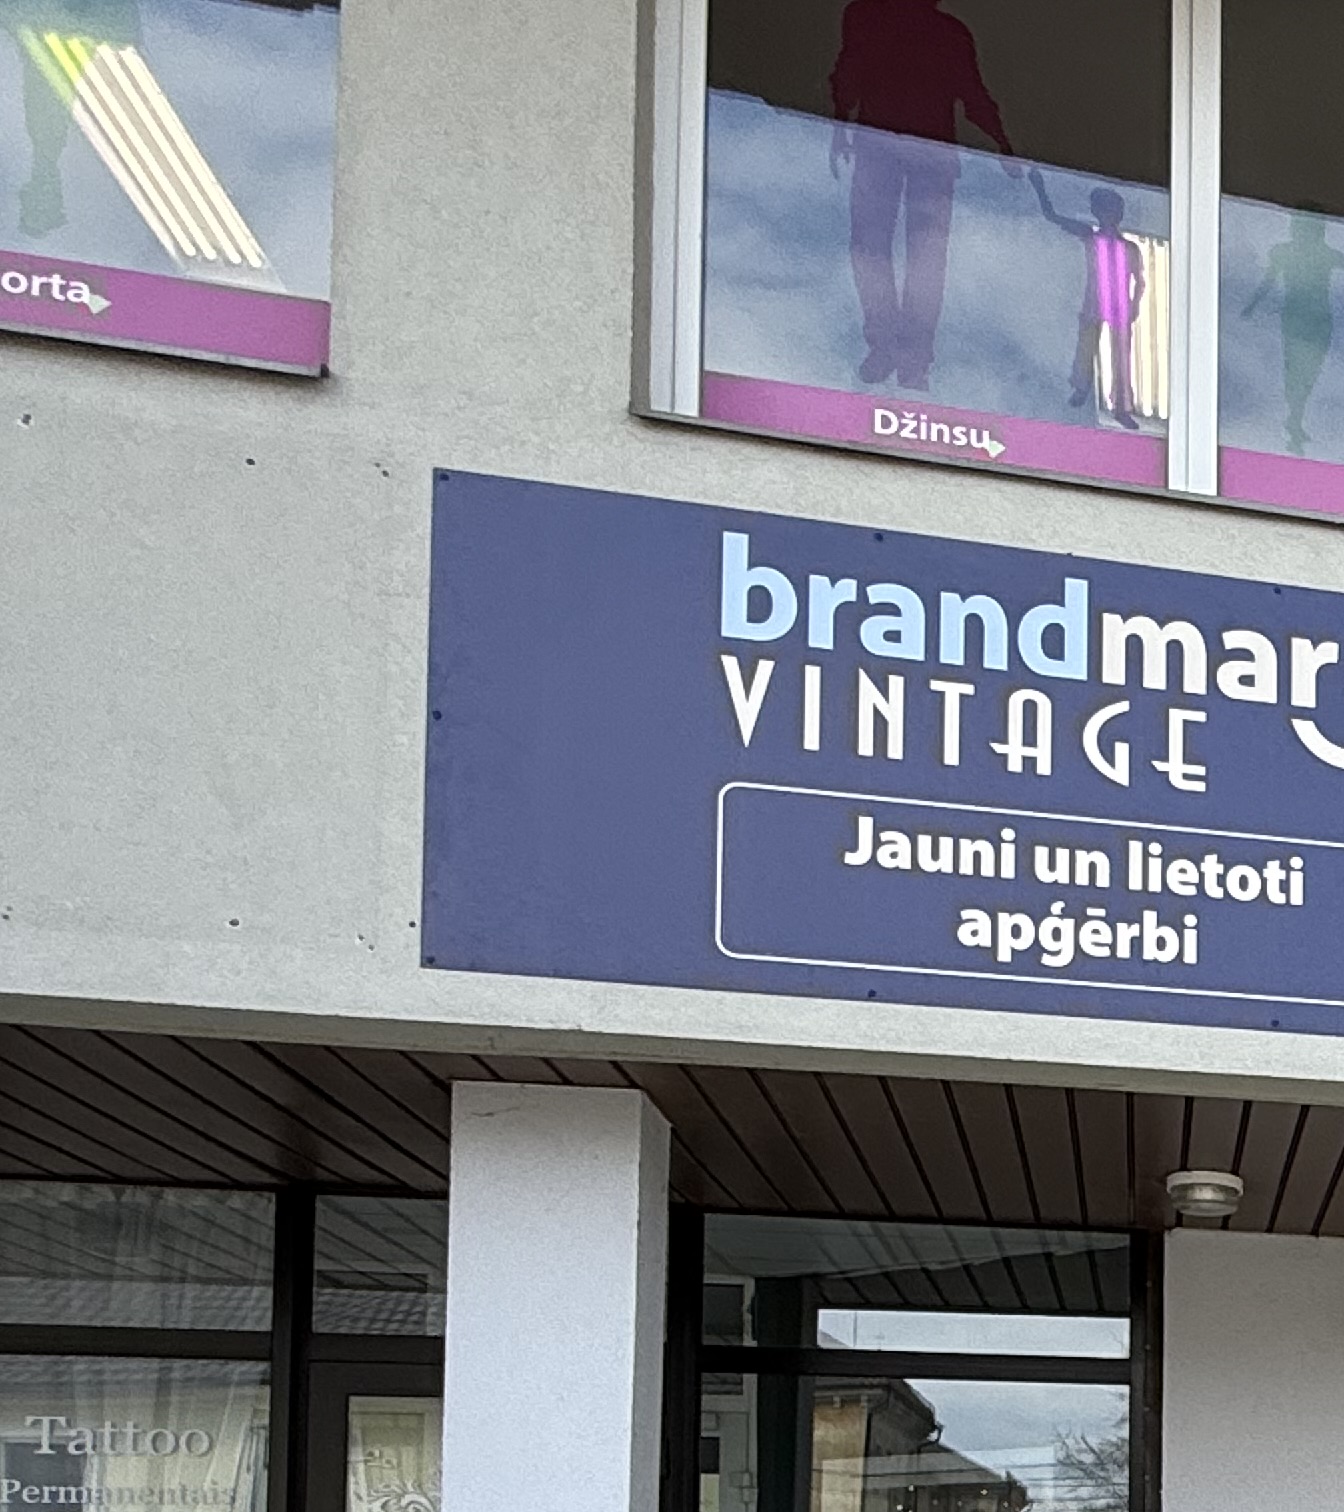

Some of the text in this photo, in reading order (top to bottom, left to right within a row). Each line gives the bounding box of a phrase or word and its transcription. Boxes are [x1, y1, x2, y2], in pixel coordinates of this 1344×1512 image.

[875, 409, 990, 449] Džinsu
[720, 655, 1208, 793] VINTAGE
[844, 816, 1305, 906] Jauni un lietoti
[956, 900, 1199, 968] apģērbi
[25, 1415, 212, 1456] Tattoo
